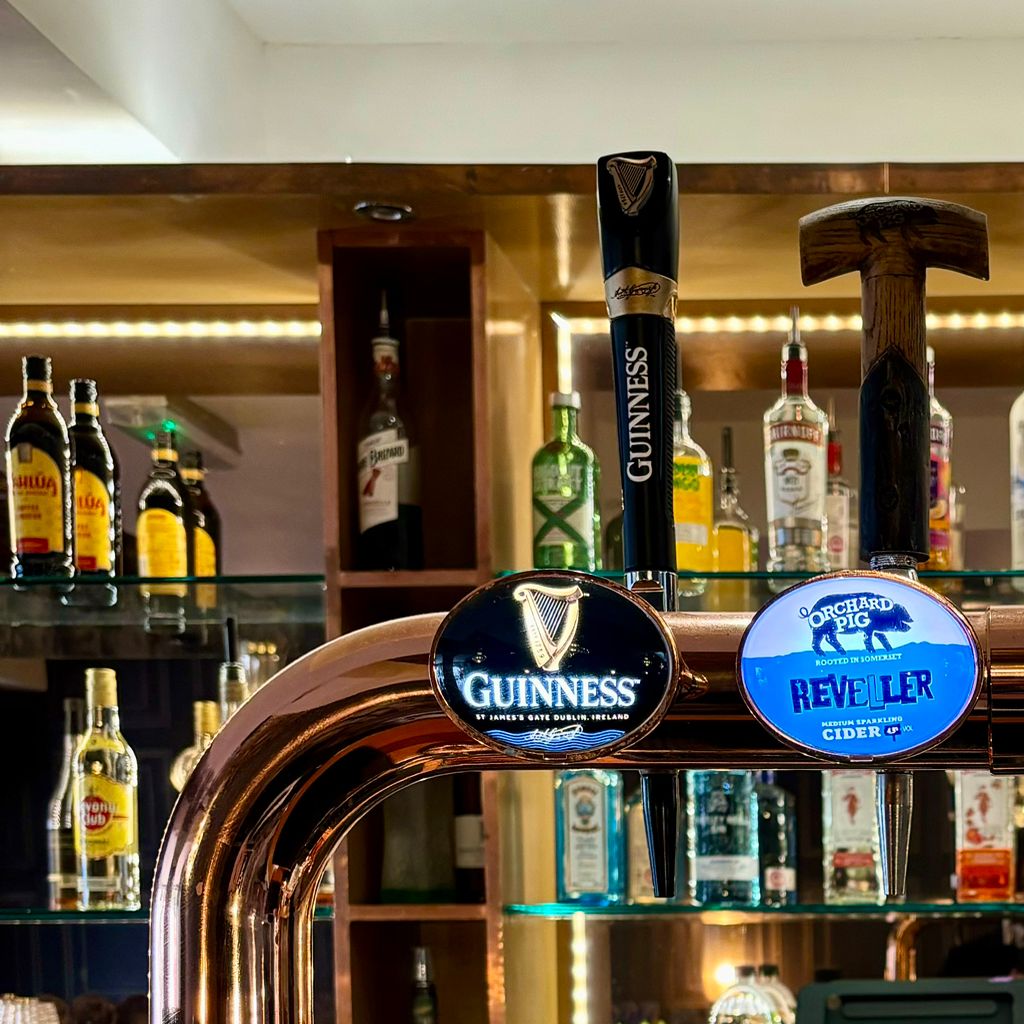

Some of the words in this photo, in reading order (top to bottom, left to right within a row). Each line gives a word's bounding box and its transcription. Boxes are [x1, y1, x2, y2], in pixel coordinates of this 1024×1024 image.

[625, 346, 652, 483] GUINNESS
[808, 596, 894, 628] ORCHARD
[834, 611, 871, 633] PIG
[815, 656, 849, 667] ROOTED
[850, 656, 859, 664] IN
[860, 653, 902, 663] SOMERSET
[463, 672, 637, 708] GUINNESS
[790, 669, 934, 714] REVELLER
[475, 713, 485, 721] ST
[489, 713, 525, 721] JAMES'S
[527, 713, 550, 721] GATE
[591, 713, 630, 721] IRELAND
[821, 719, 854, 727] MEDIUM
[856, 716, 903, 726] SPARKLING
[821, 726, 882, 741] CIDER
